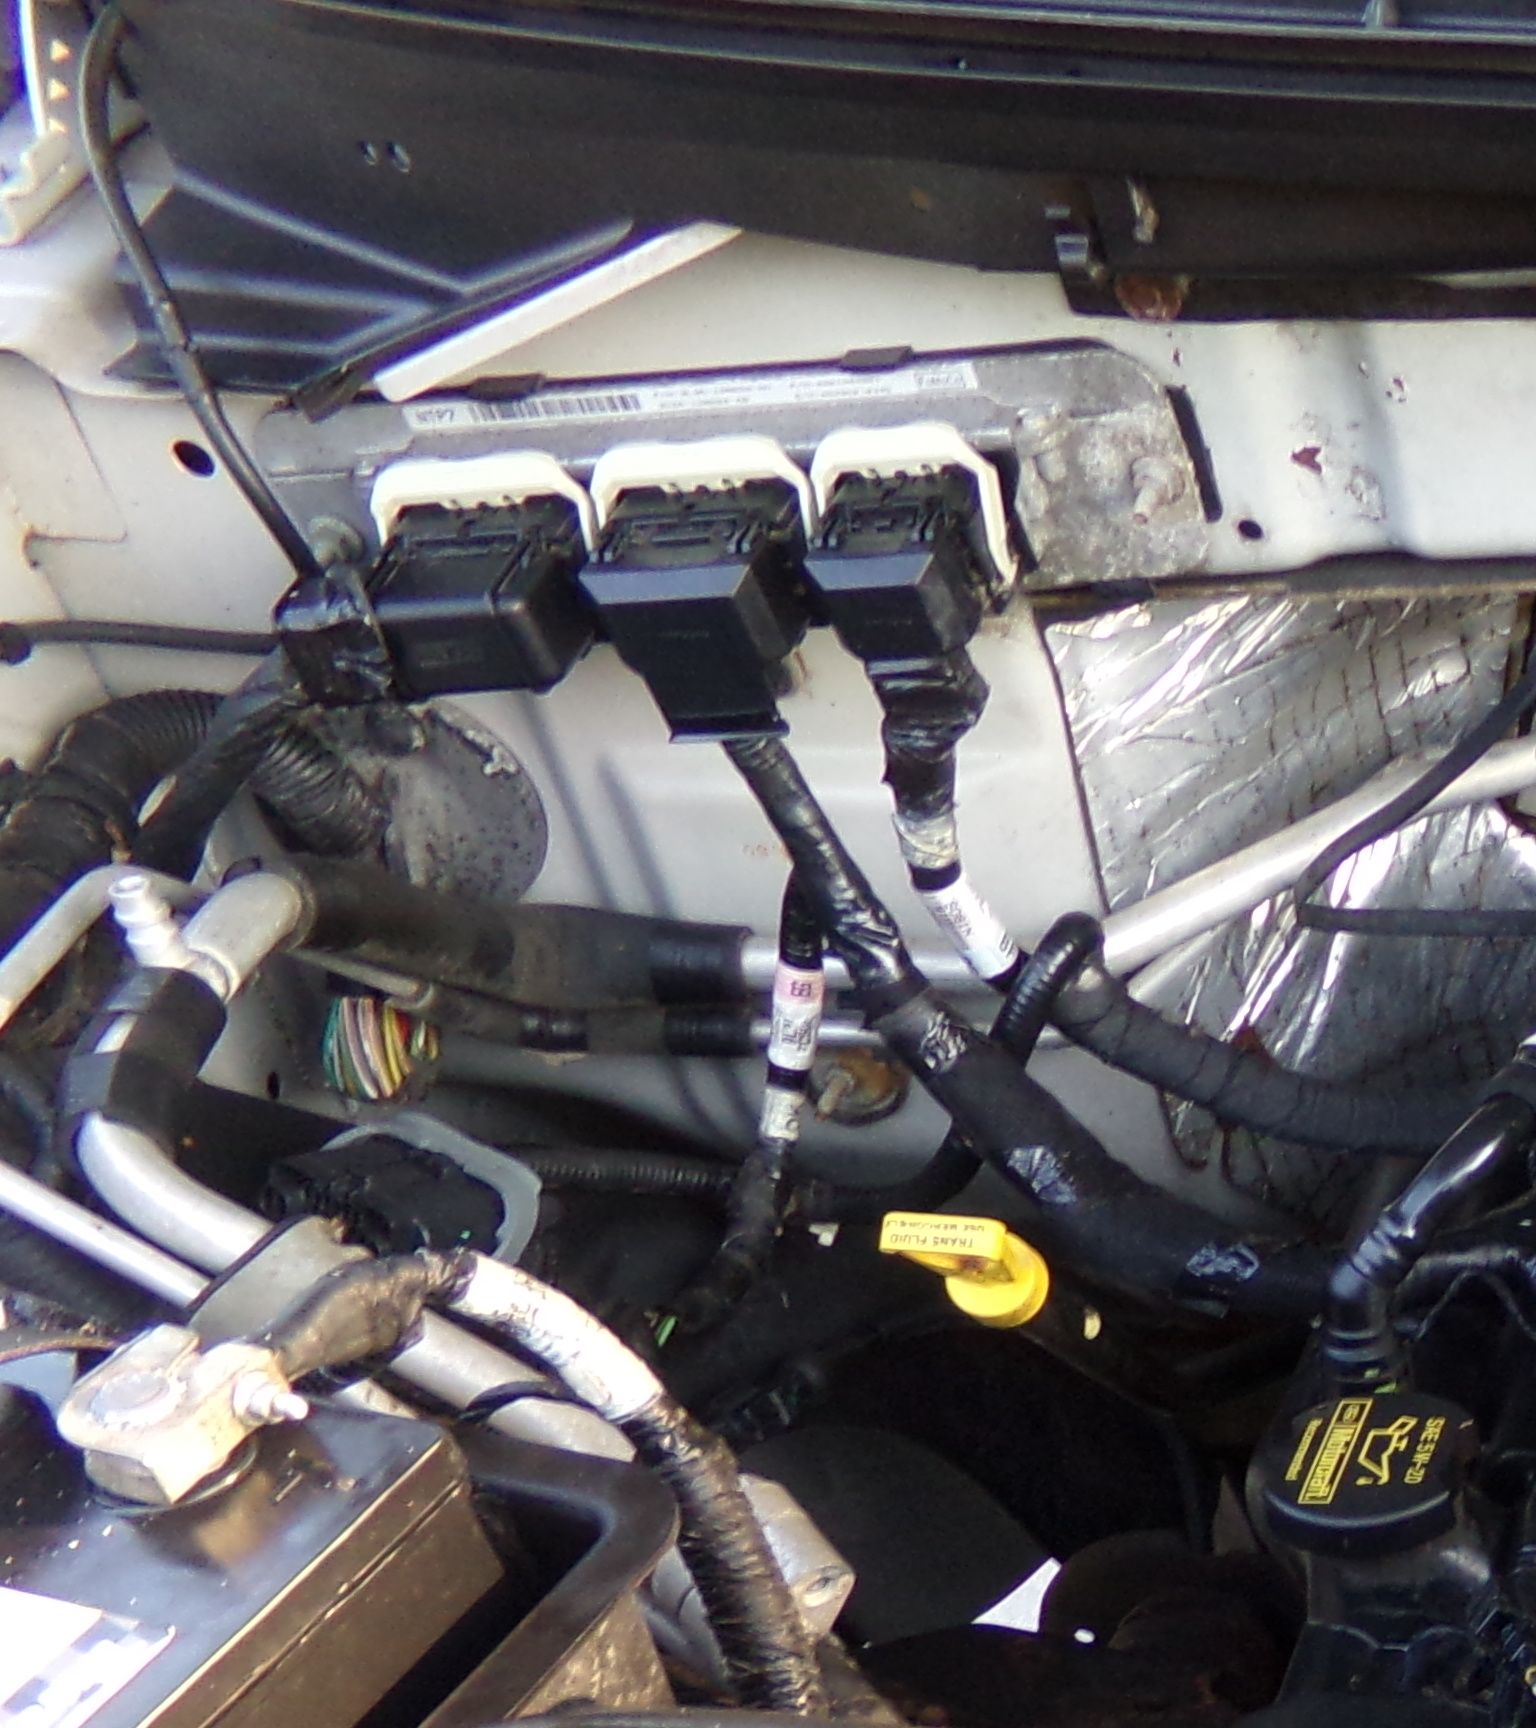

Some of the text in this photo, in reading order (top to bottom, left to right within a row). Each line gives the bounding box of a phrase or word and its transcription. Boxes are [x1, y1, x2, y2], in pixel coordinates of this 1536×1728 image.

[890, 1233, 975, 1248] TRANS FLUID
[1305, 1427, 1355, 1500] Motorcraft
[1403, 1440, 1437, 1485] 5W-20
